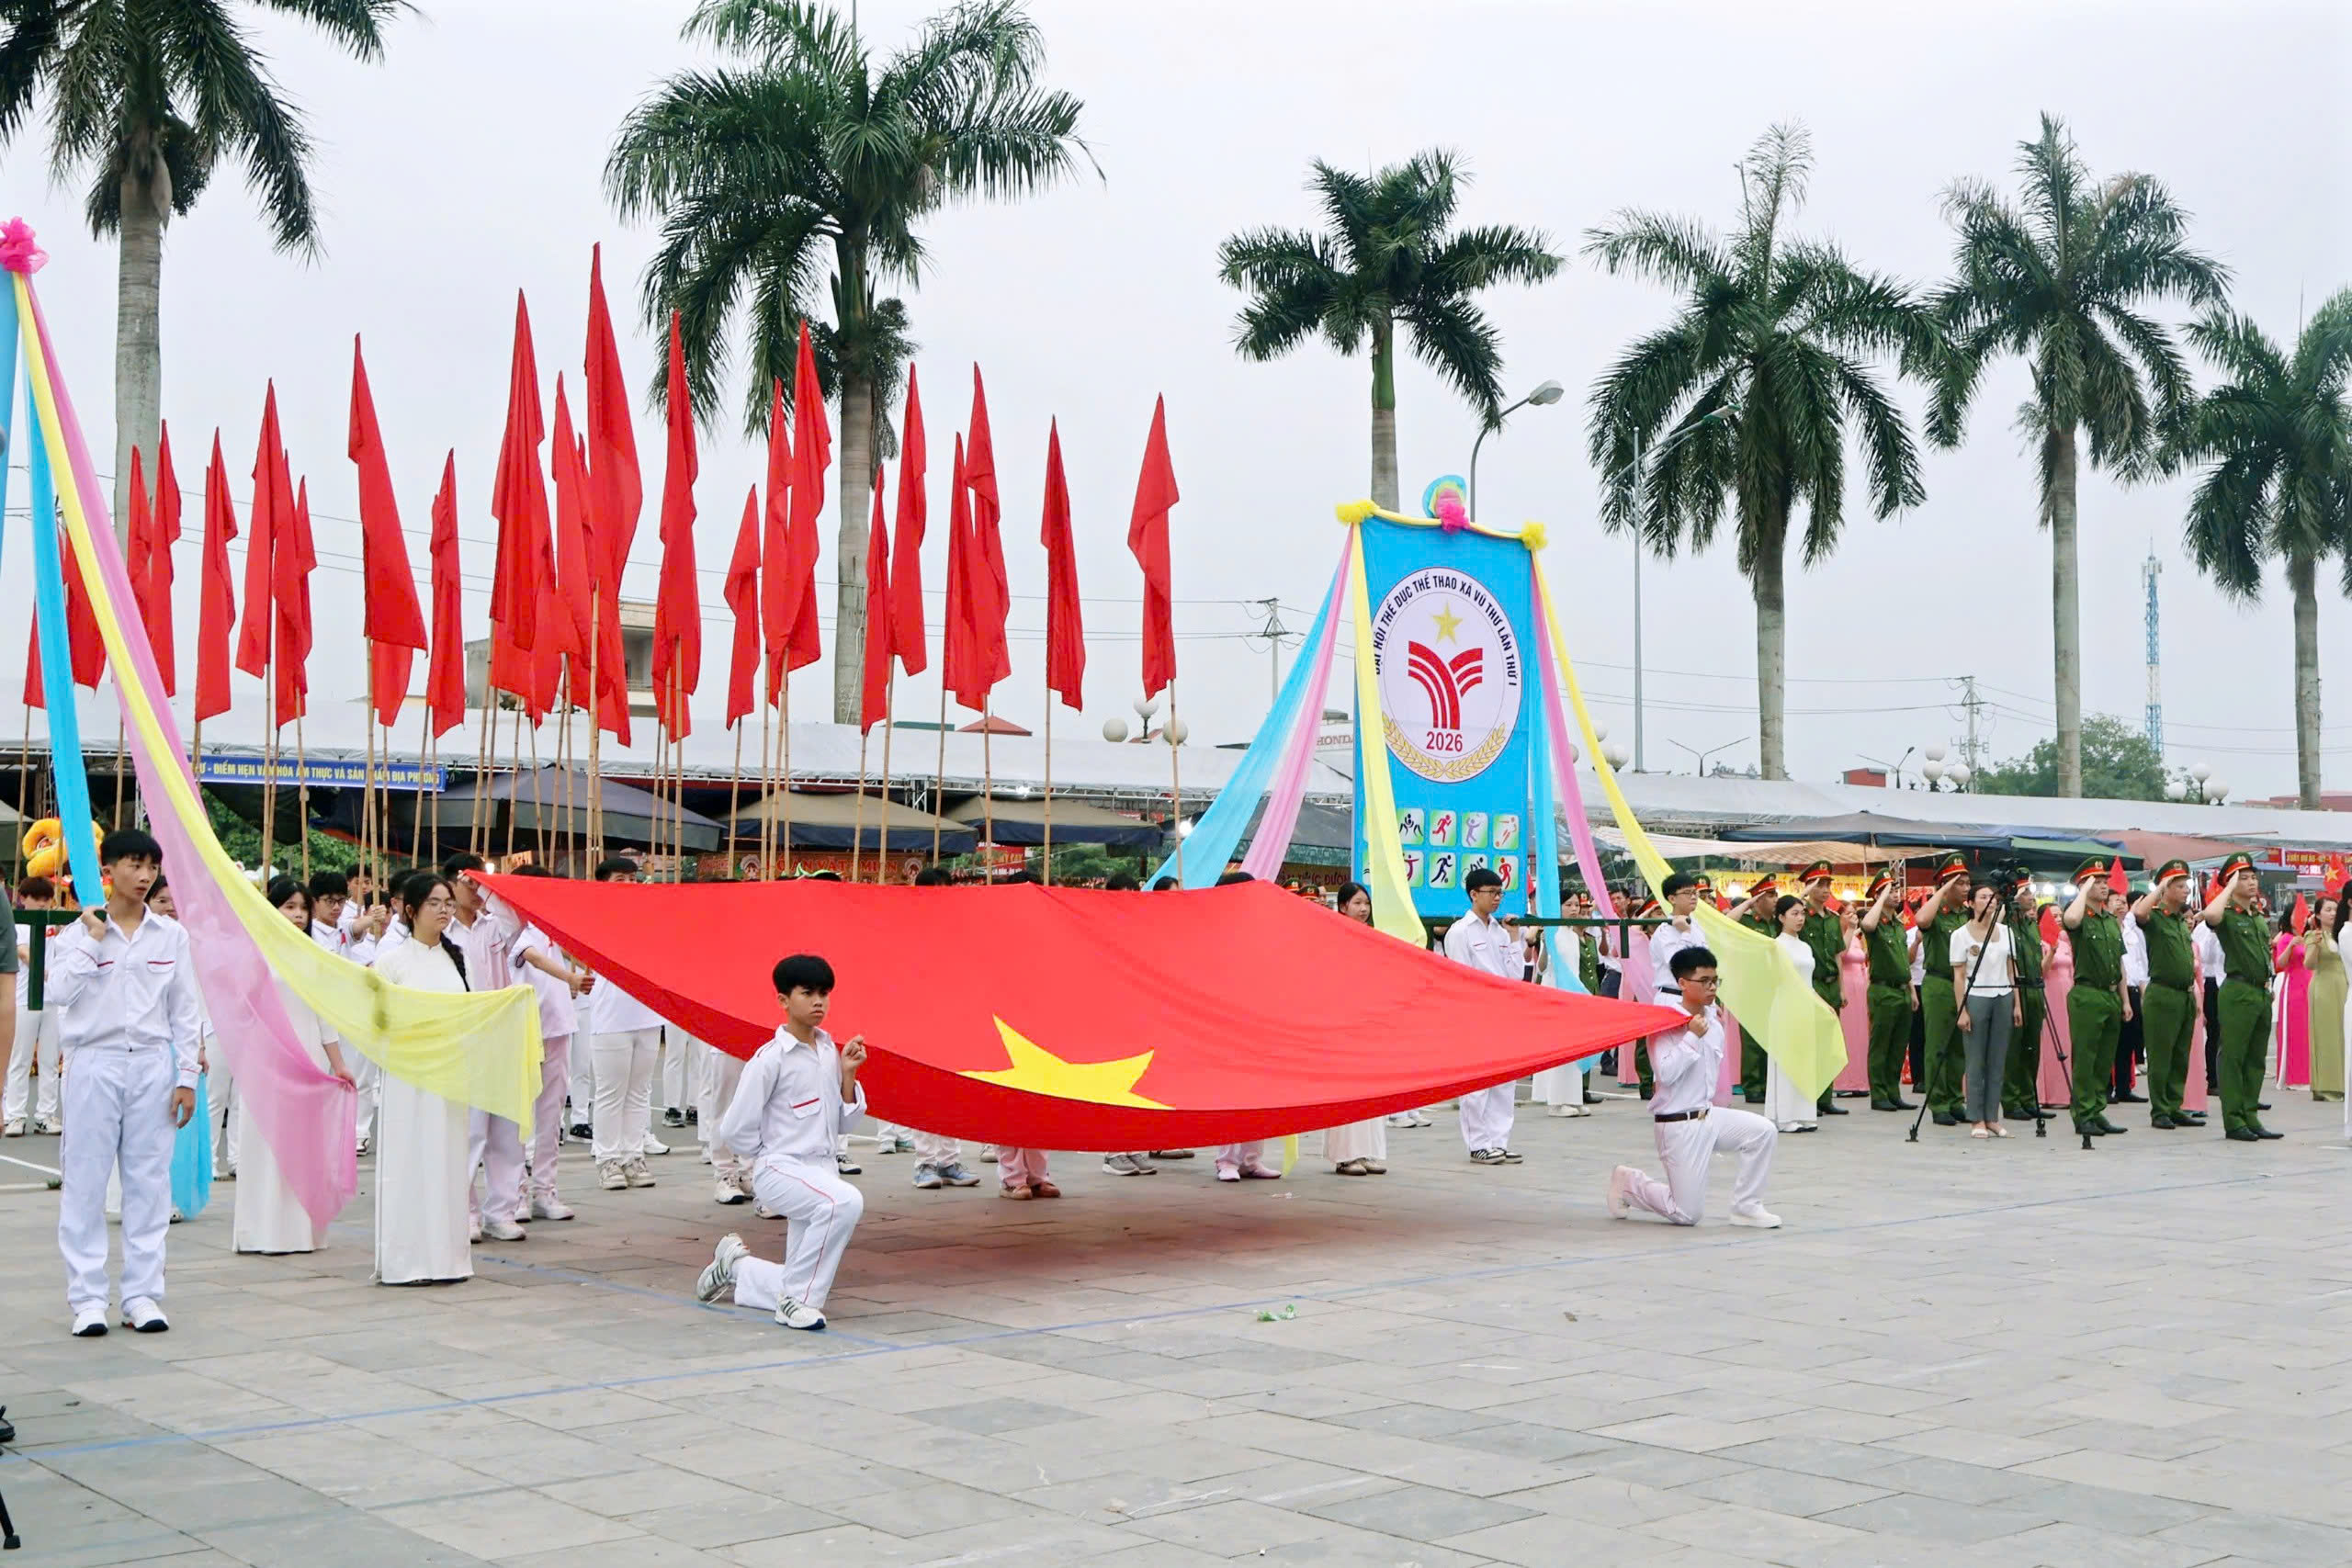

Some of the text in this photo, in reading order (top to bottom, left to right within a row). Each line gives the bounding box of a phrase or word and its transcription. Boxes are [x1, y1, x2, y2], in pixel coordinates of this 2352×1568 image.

[1373, 626, 1386, 650] HỘI
[1380, 598, 1397, 627] THỂ
[1393, 585, 1413, 608] DỤC
[1412, 571, 1430, 592] THỂ
[1432, 575, 1457, 590] THAO
[1459, 581, 1472, 597] XÃ
[1474, 590, 1487, 607] VŨ
[1485, 603, 1503, 626] THƯ
[1506, 653, 1518, 680] THỨ
[1317, 735, 1353, 746] HOND
[1426, 731, 1463, 752] 2026
